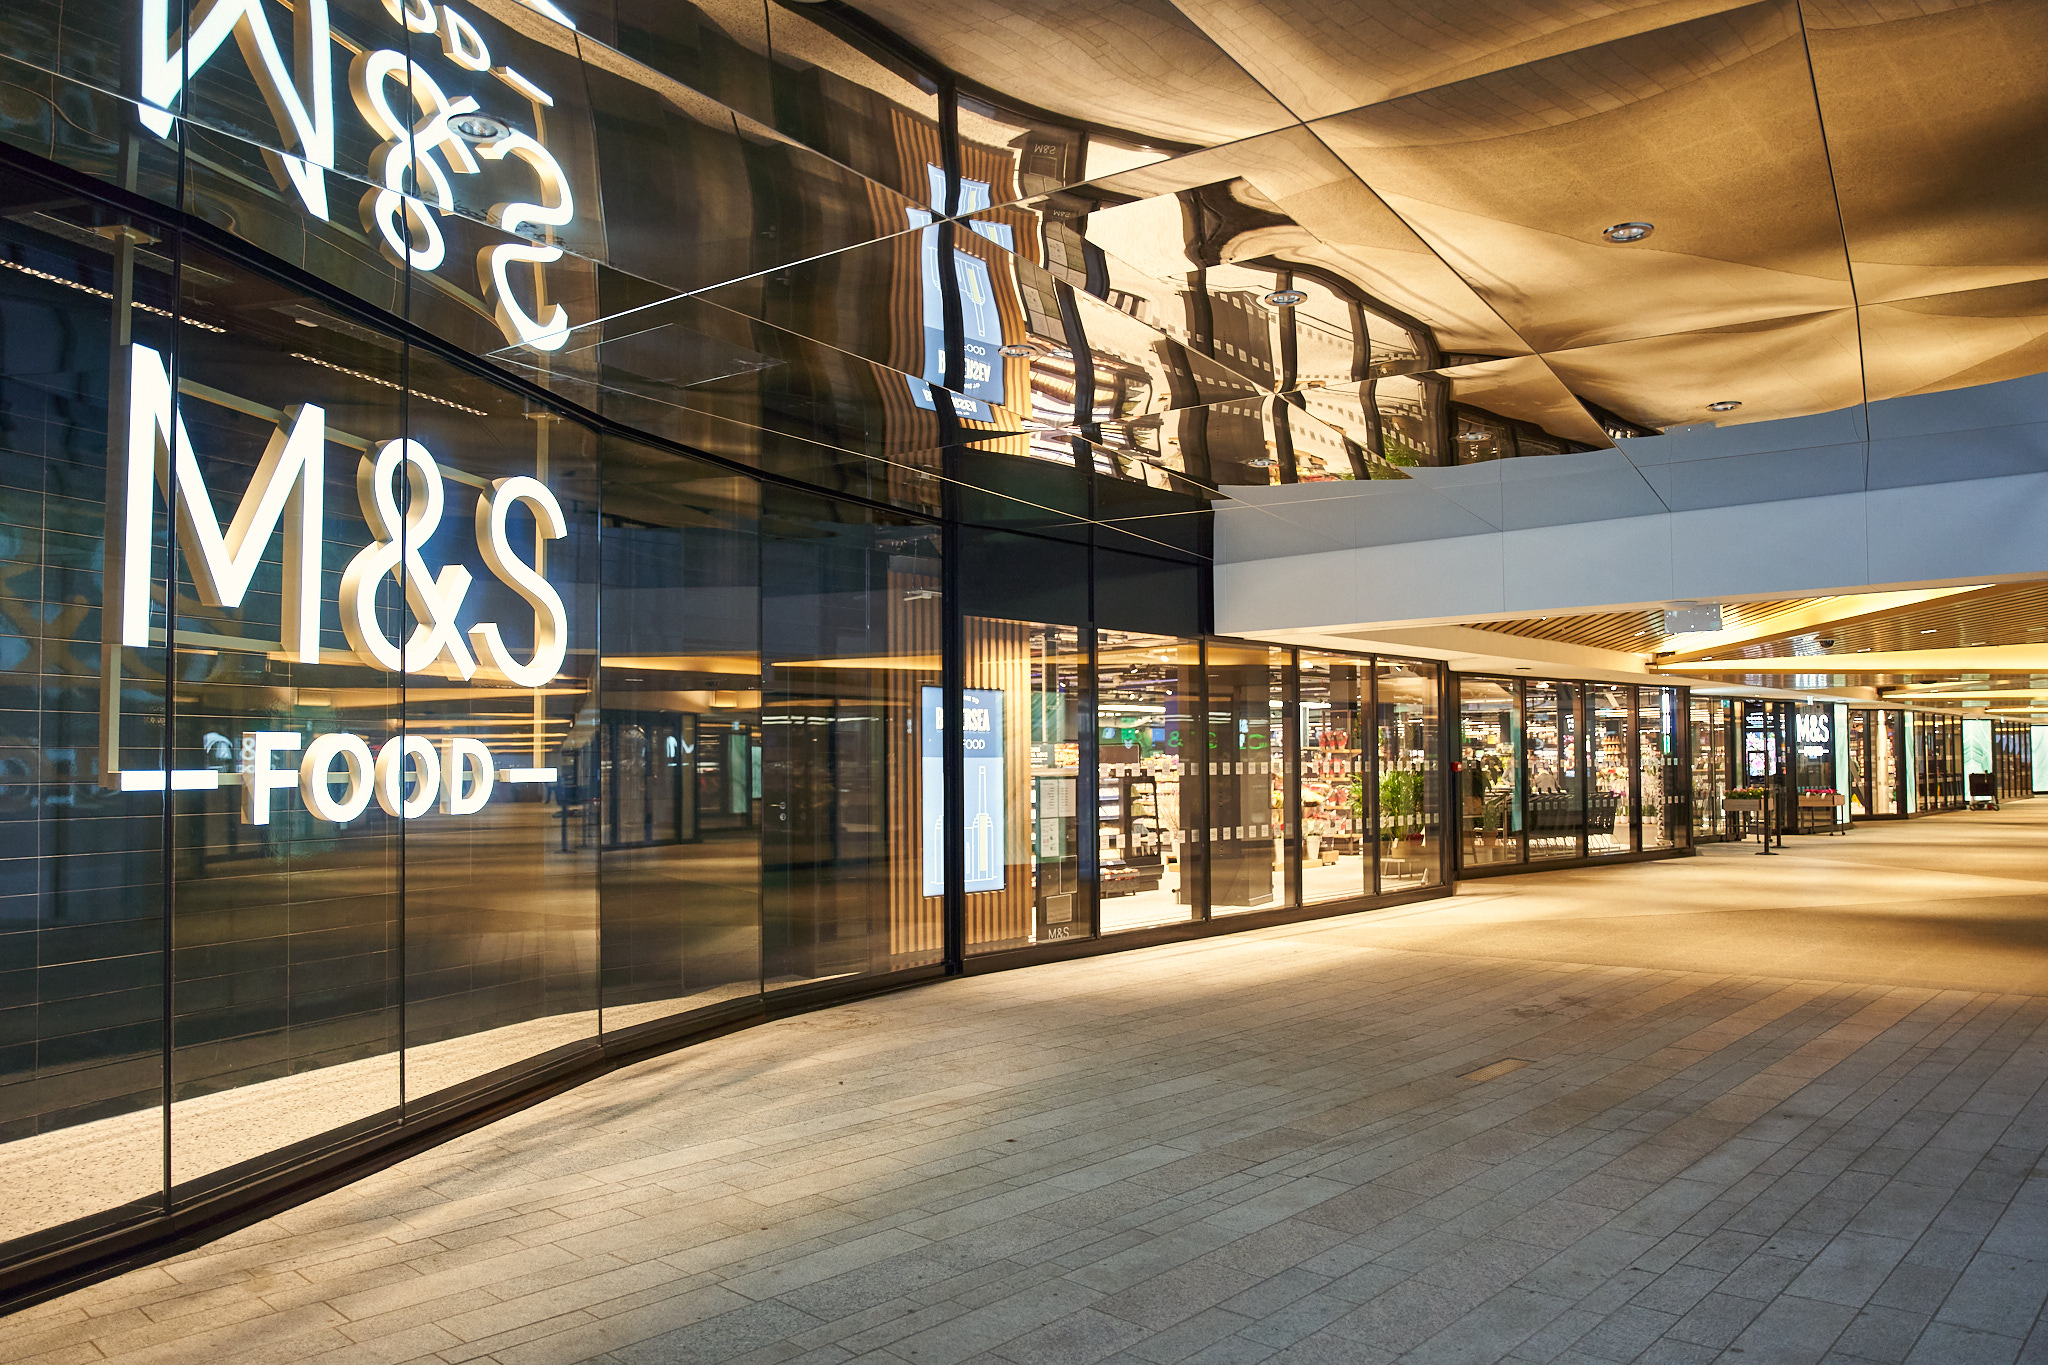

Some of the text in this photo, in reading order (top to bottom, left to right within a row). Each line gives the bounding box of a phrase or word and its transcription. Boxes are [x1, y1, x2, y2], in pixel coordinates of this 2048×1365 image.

[122, 343, 568, 687] M&S
[1796, 714, 1829, 743] M&S
[252, 731, 495, 825] FOOD
[1048, 926, 1070, 940] M&S
